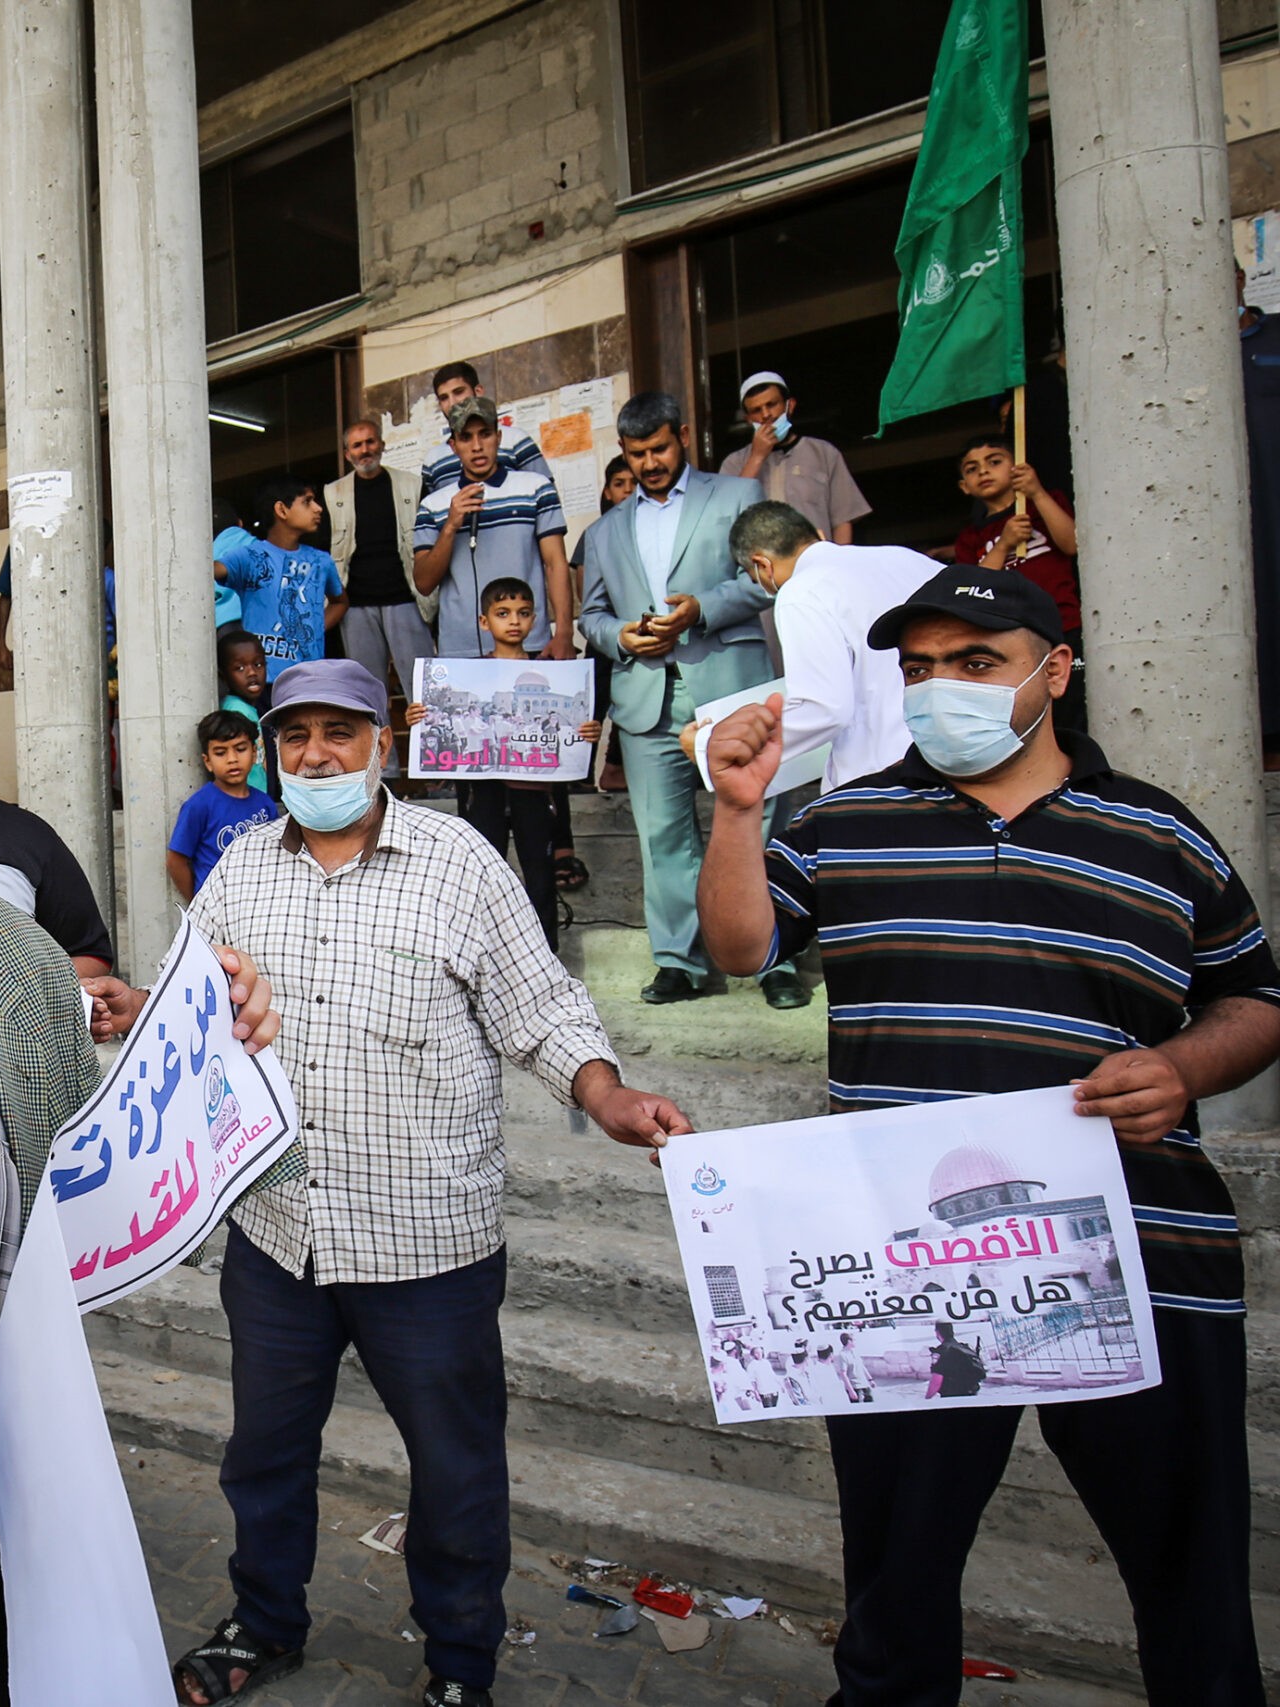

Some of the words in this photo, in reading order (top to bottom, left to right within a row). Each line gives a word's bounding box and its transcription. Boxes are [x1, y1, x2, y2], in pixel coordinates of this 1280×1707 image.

[954, 586, 995, 600] FILA
[258, 633, 300, 660] GER
[510, 730, 558, 748] يوقف
[185, 975, 217, 1077] من
[120, 1023, 181, 1160] غزة
[227, 1115, 273, 1165] حماس
[885, 1217, 1060, 1268] الأقصى
[789, 1250, 874, 1289] يصرخ
[781, 1290, 934, 1332] معتصم؟
[945, 1288, 999, 1320] من
[1011, 1275, 1072, 1315] هل
